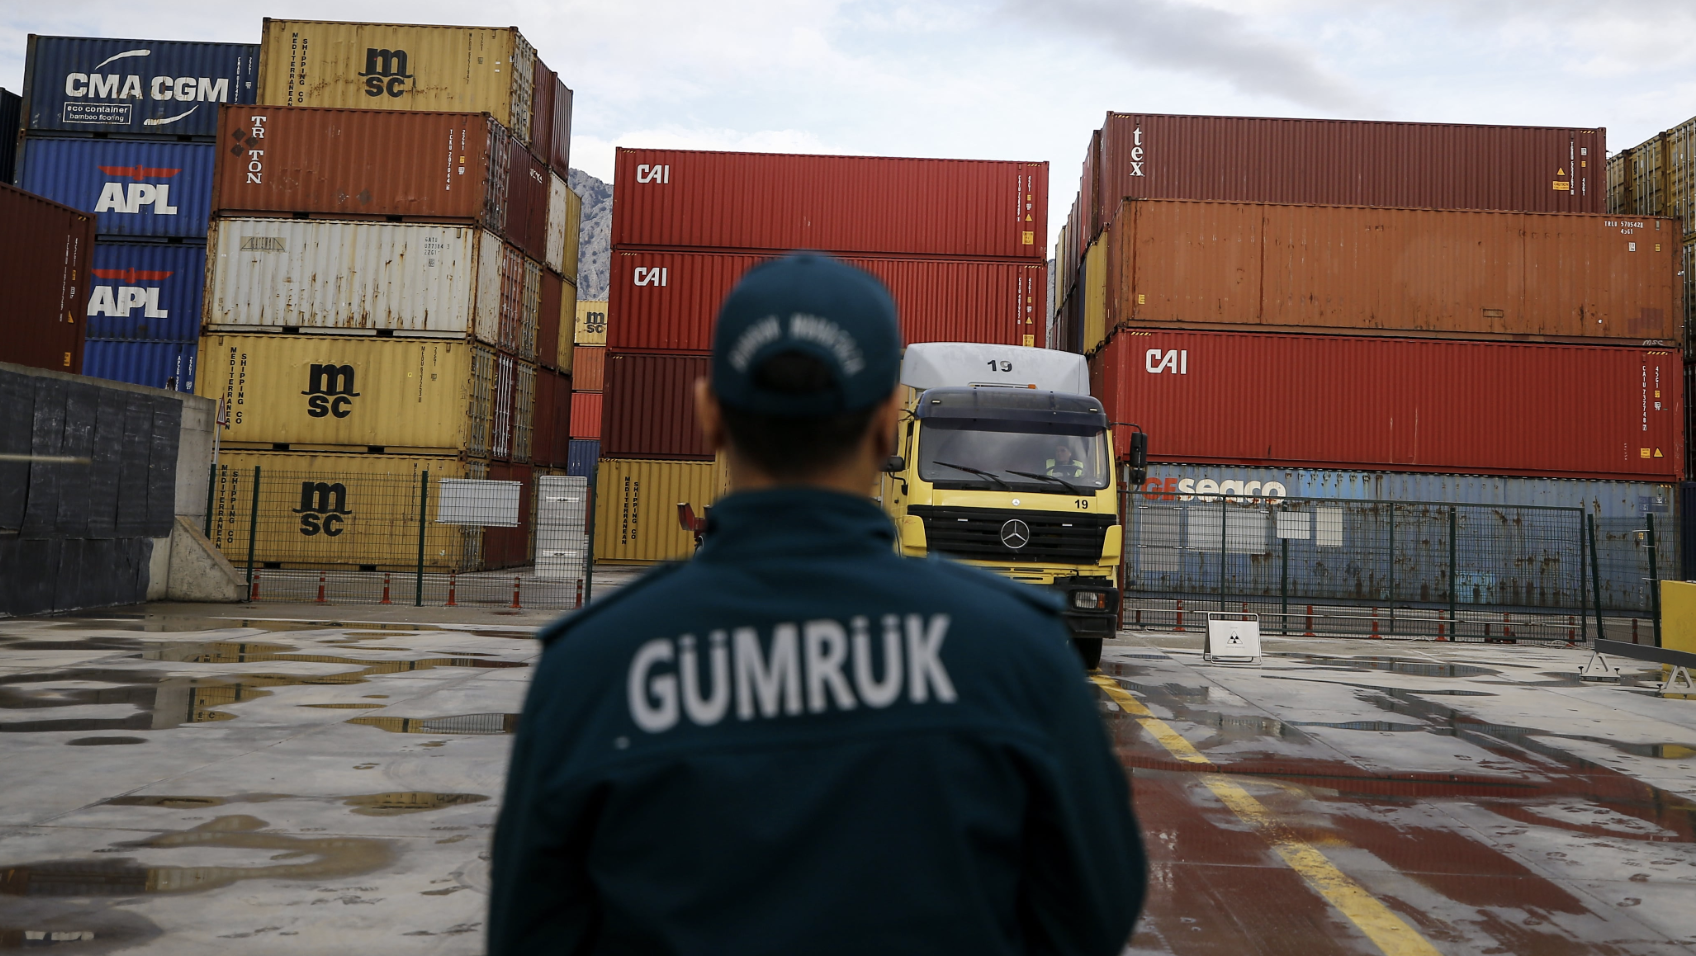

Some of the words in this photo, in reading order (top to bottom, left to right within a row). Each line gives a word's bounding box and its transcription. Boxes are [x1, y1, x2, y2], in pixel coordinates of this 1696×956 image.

[299, 38, 308, 86] SHIPPING
[65, 72, 143, 99] CMA
[150, 76, 229, 103] CGM
[297, 91, 304, 103] CO
[1130, 127, 1144, 177] tex
[636, 164, 669, 184] CAI
[94, 182, 177, 214] APL
[634, 267, 667, 287] CAI
[87, 285, 168, 319] APL
[987, 359, 1012, 372] 19
[1145, 348, 1187, 374] CAI
[224, 347, 237, 430] MEDITERRANEAN
[237, 353, 247, 405] SHIPPING
[235, 411, 242, 424] CO
[228, 471, 238, 524] SHIPPING
[621, 476, 631, 545] MEDITERRANEAN
[1074, 500, 1088, 510] 19
[631, 528, 637, 540] CO
[627, 613, 957, 734] GÜMRÜK
